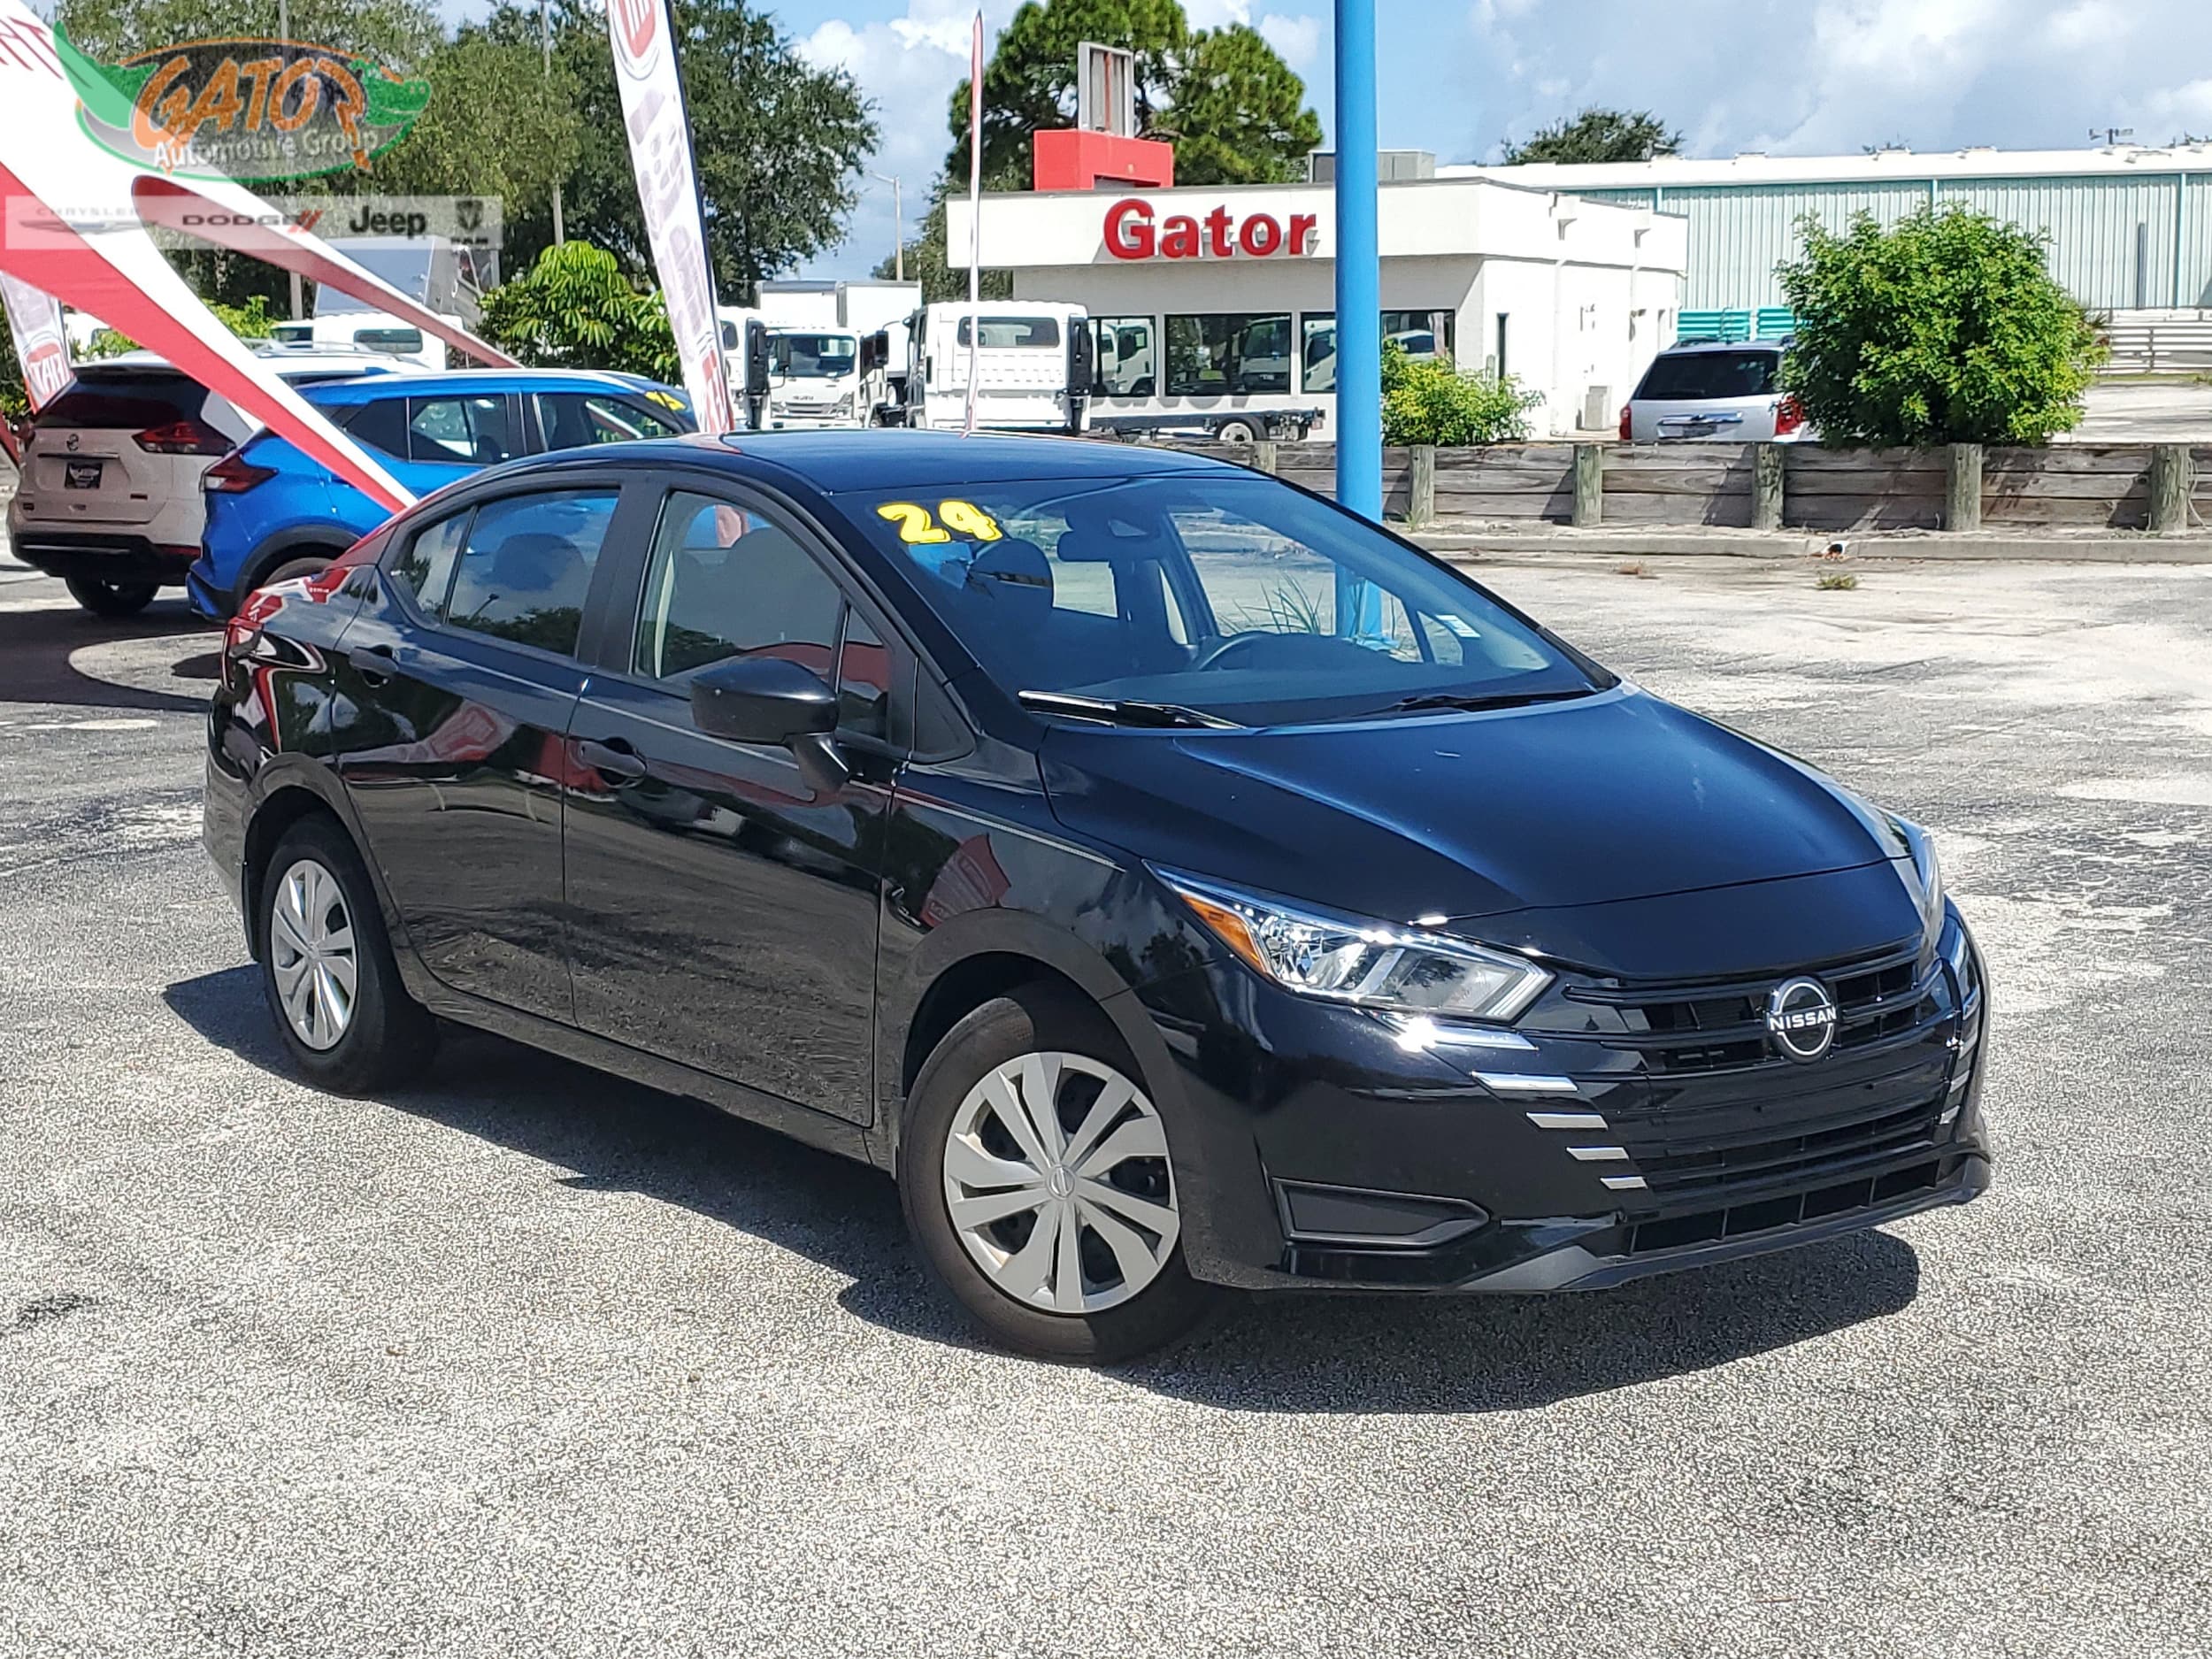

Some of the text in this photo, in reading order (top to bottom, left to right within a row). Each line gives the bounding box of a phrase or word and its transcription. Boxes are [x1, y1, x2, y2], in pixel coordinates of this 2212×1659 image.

[1103, 198, 1317, 258] Gator
[877, 499, 1003, 542] 24
[1770, 1006, 1836, 1031] NISSAN
